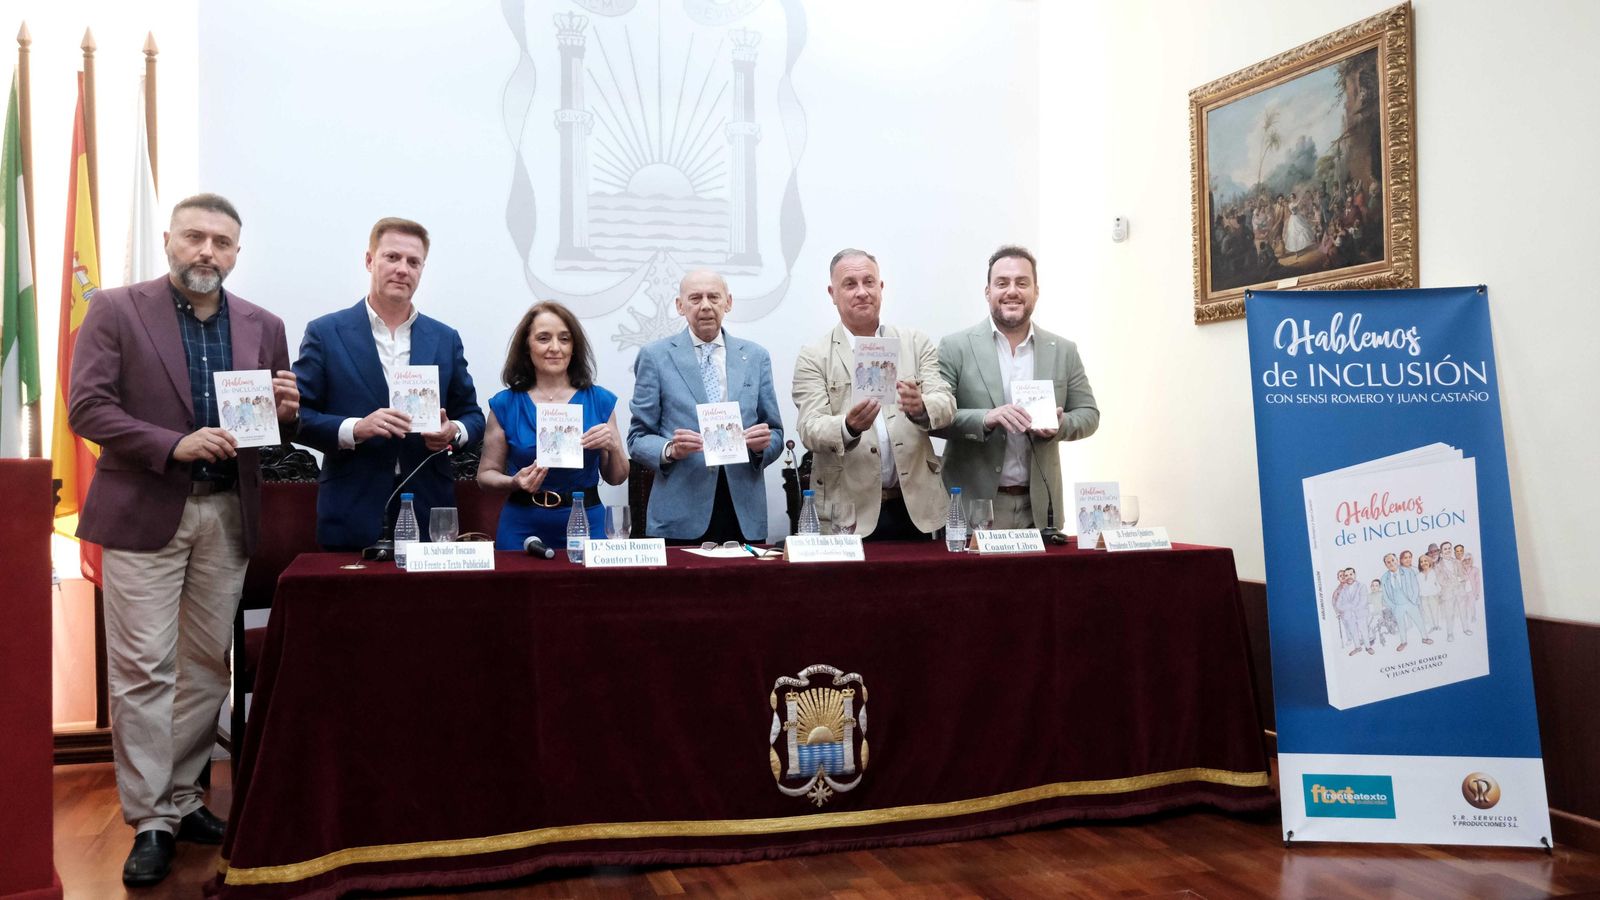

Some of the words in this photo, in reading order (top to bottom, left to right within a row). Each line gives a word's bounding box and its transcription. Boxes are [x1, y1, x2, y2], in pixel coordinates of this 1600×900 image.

[1273, 312, 1421, 357] Hablemos
[1262, 362, 1298, 388] de
[1310, 354, 1488, 388] INCLUSIÓN
[1266, 394, 1293, 404] CON
[1296, 394, 1328, 404] SENSI
[1332, 393, 1384, 404] ROMERO
[1386, 393, 1394, 403] Y
[1397, 393, 1428, 404] JUAN
[1431, 390, 1489, 403] CASTAÑO
[1336, 491, 1423, 526] Hablemos
[1335, 529, 1357, 547] de
[1363, 508, 1465, 542] INCLUSIÓN
[978, 532, 987, 541] D.
[989, 531, 1007, 540] Juan
[1008, 530, 1039, 540] Castaño
[605, 541, 627, 551] Sensi
[629, 541, 662, 551] Romero
[984, 543, 1015, 551] Coautor
[1016, 542, 1038, 550] Libro
[593, 555, 632, 564] Coautora
[635, 554, 659, 564] Libro
[1380, 665, 1396, 673] CON
[1398, 660, 1417, 669] SENSI
[1418, 653, 1448, 664] ROMERO
[1392, 669, 1410, 678] JUAN
